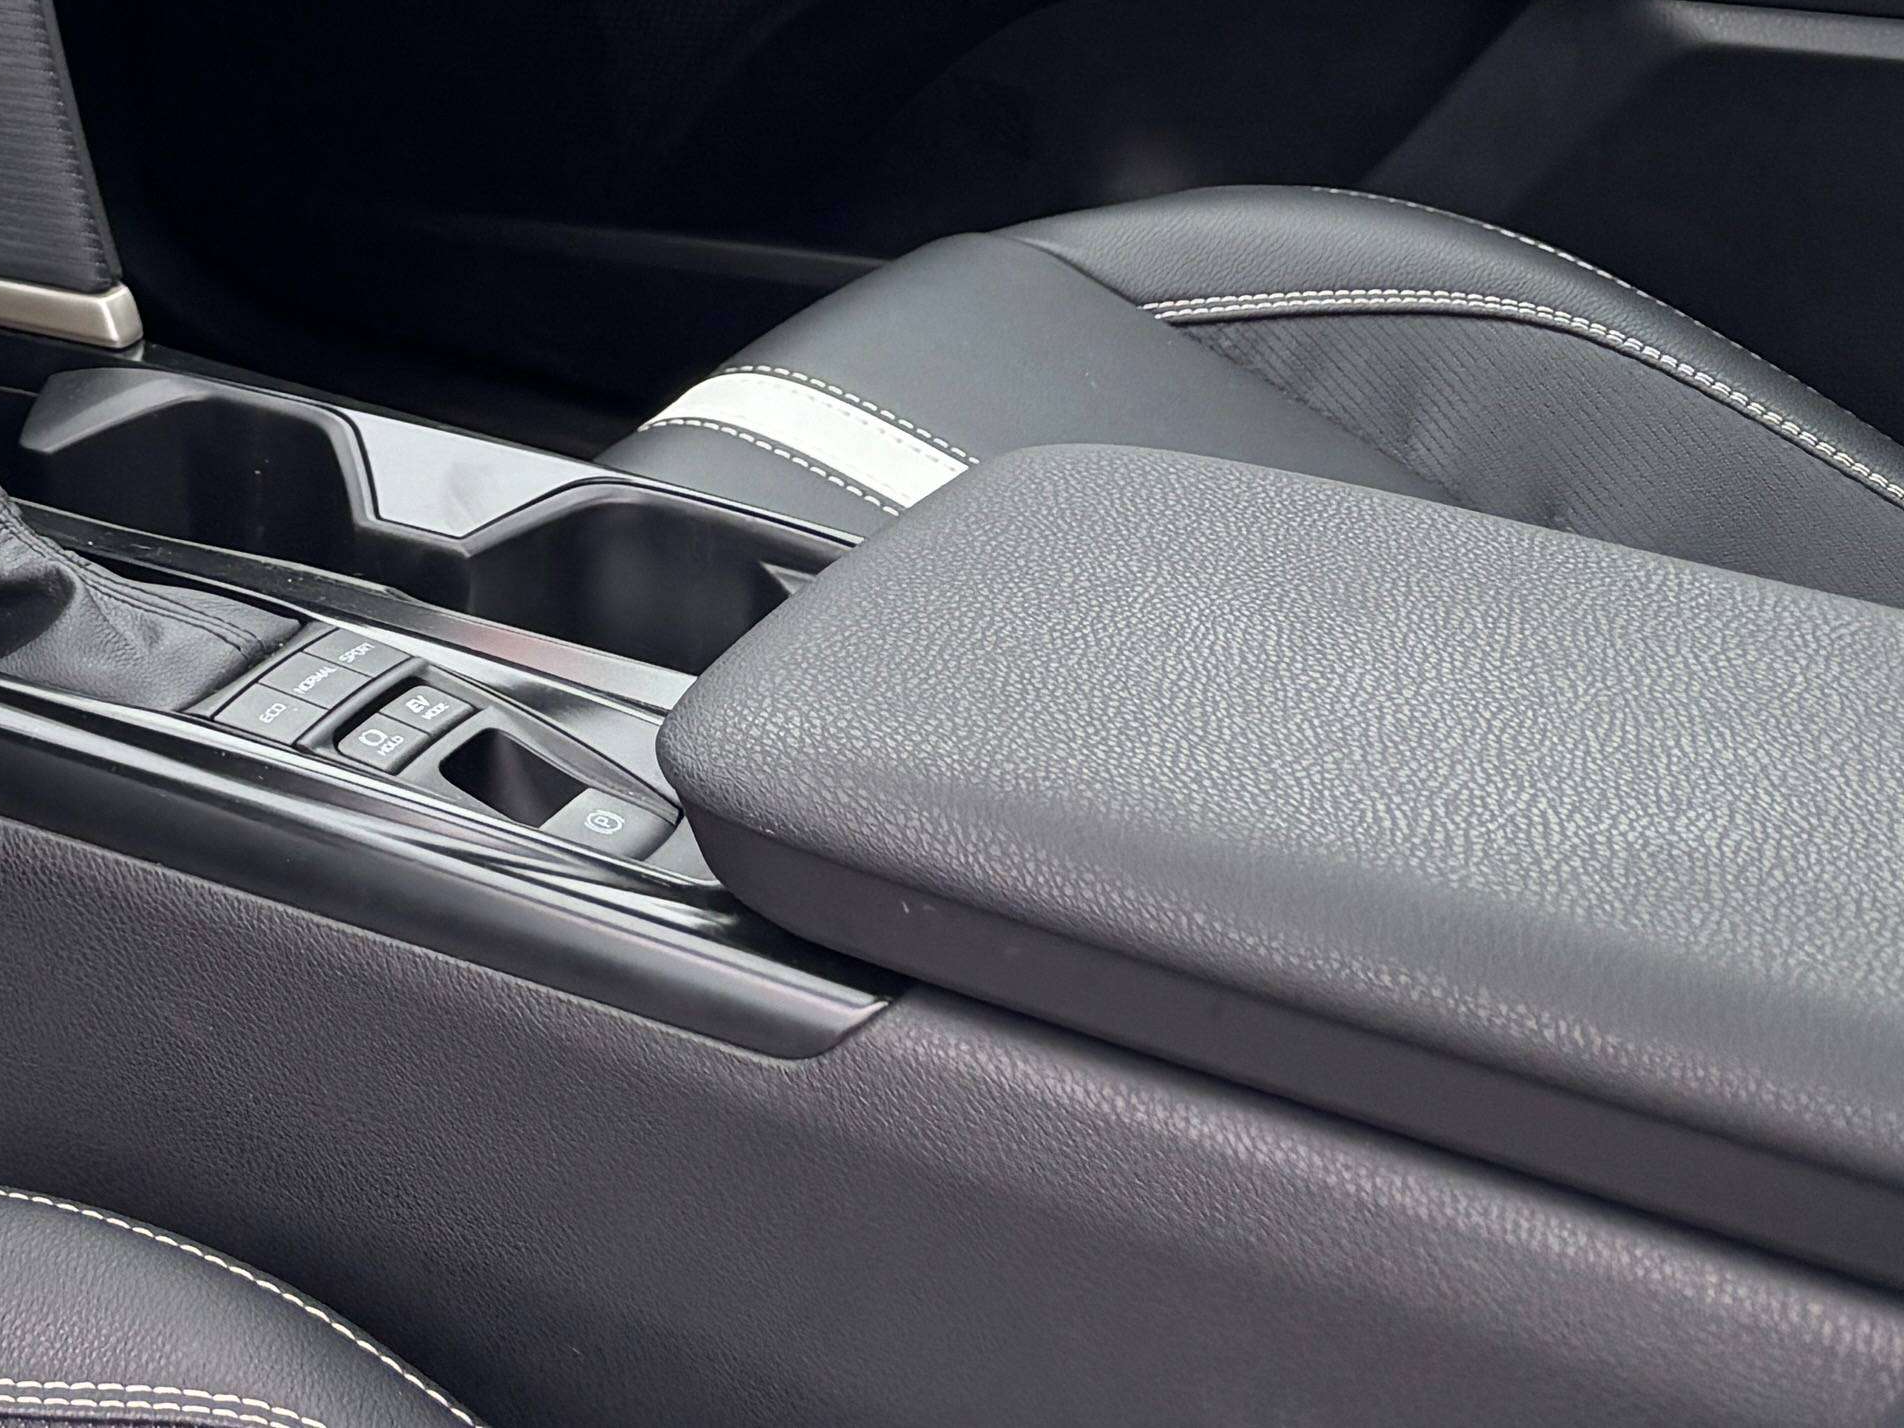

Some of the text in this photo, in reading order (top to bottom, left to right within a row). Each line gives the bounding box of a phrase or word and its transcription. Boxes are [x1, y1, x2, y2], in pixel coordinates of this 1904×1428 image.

[338, 642, 375, 664] SPORT
[293, 665, 339, 695] NORMAL
[259, 702, 287, 724] ECO
[405, 694, 431, 714] EV
[377, 735, 405, 756] HOLD
